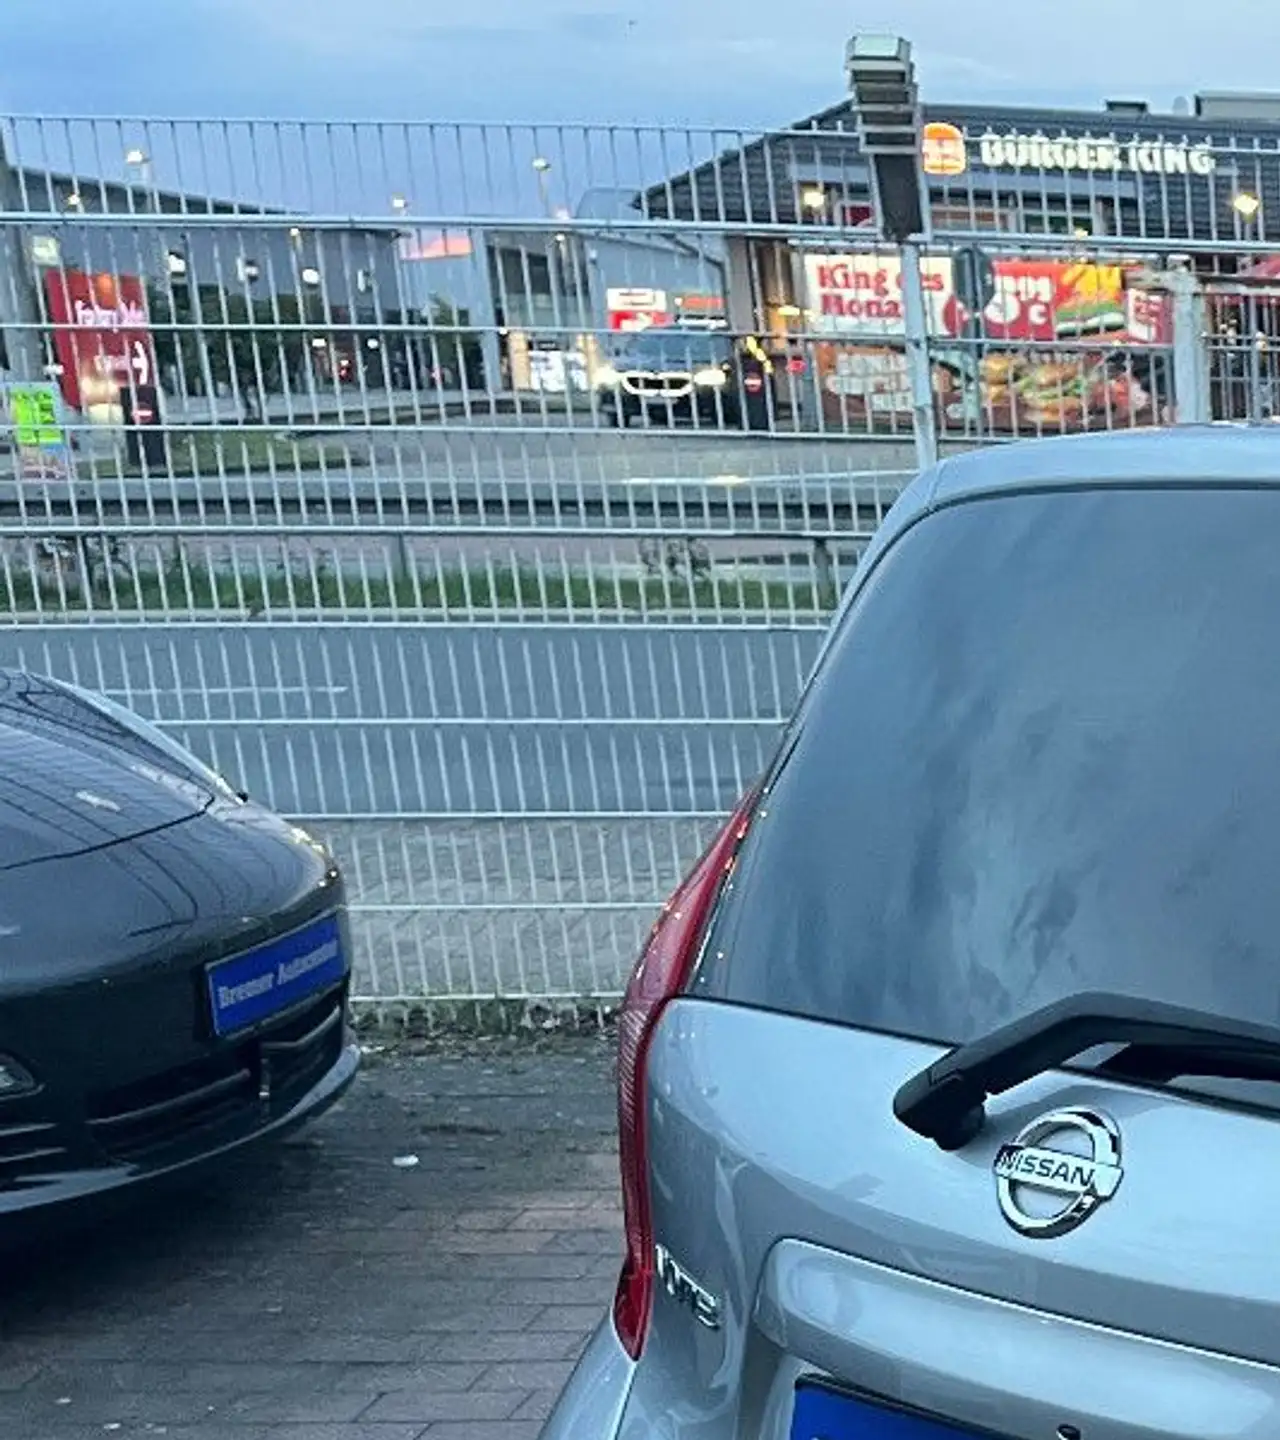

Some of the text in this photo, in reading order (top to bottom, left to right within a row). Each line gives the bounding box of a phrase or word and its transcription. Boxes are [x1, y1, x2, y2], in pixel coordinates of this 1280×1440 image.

[980, 134, 1216, 174] BURGER KING
[817, 263, 889, 297] King
[1000, 1151, 1095, 1187] NISSAN
